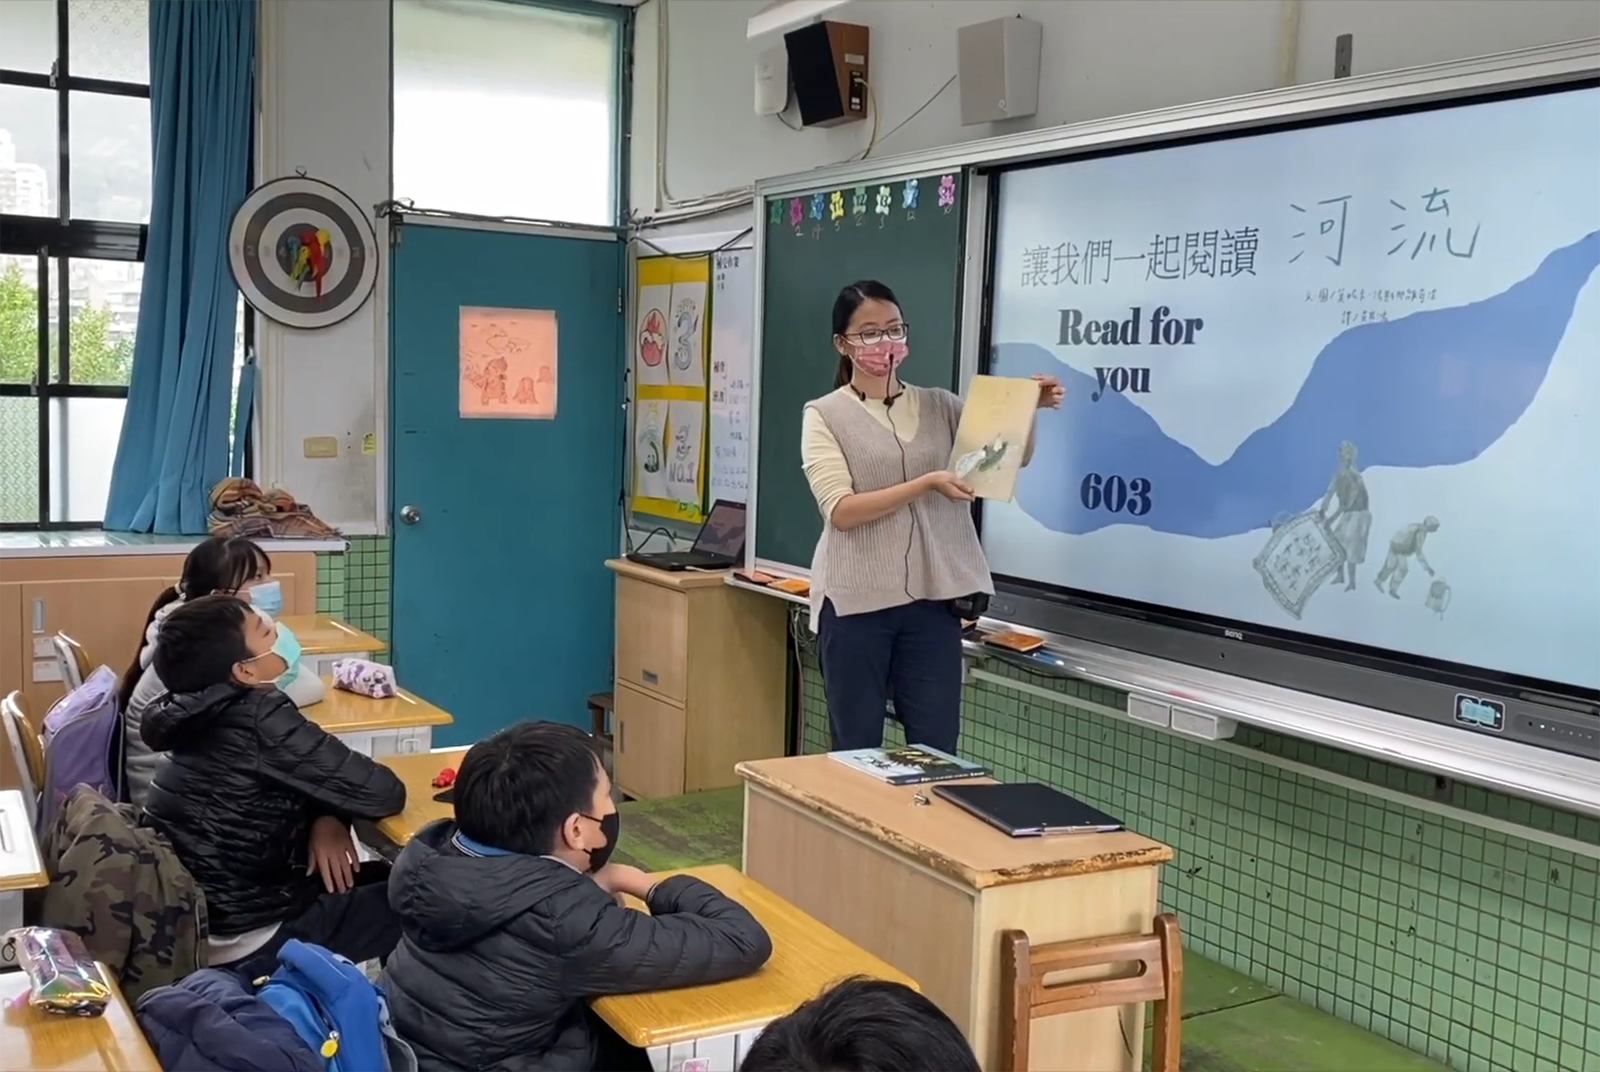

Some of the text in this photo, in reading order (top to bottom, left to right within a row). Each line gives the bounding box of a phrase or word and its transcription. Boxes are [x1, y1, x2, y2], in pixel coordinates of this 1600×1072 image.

[1288, 187, 1481, 267] 河 流
[1021, 226, 1260, 287] 讓我們一起閱讀
[1056, 305, 1204, 346] Read for
[1091, 366, 1152, 402] you
[1080, 472, 1152, 517] 603
